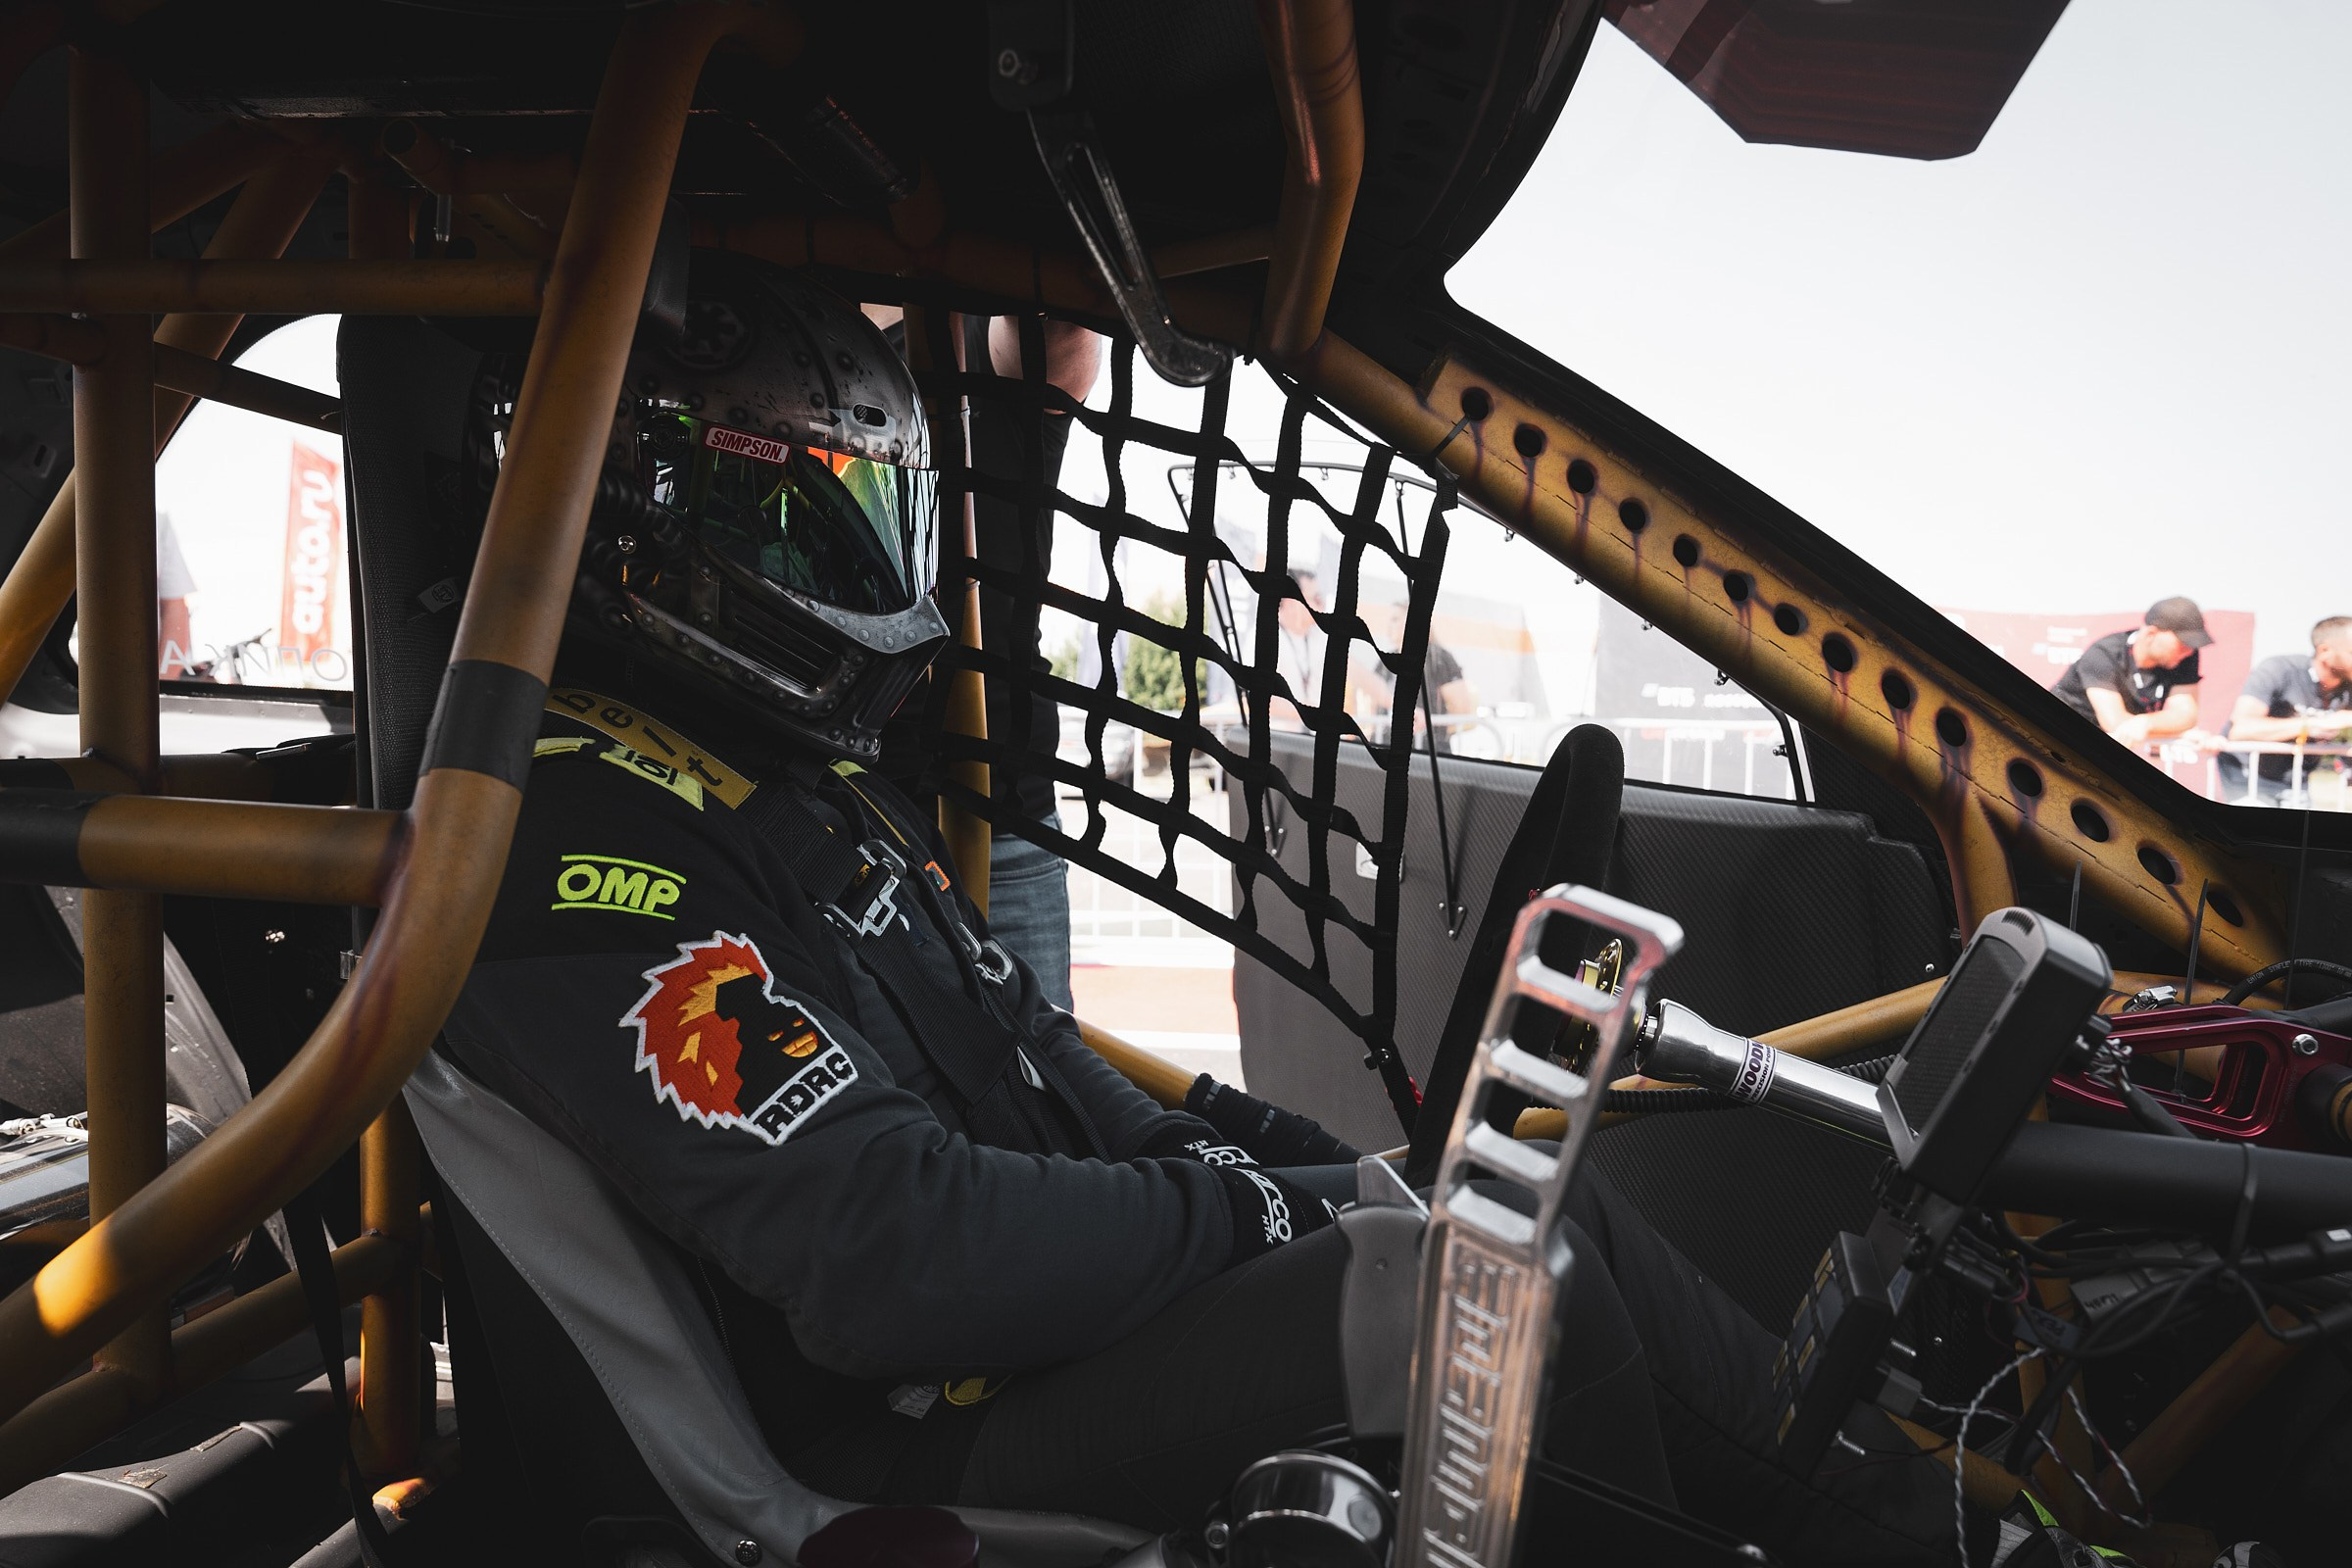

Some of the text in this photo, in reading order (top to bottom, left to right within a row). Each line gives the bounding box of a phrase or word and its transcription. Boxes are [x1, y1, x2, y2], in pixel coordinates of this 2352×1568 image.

[711, 430, 783, 461] SIMPSON
[291, 469, 334, 633] auto.ru
[552, 693, 723, 787] belt
[557, 862, 682, 912] OMP
[753, 1053, 855, 1140] ADRC
[1750, 1063, 1770, 1101] PRECISION
